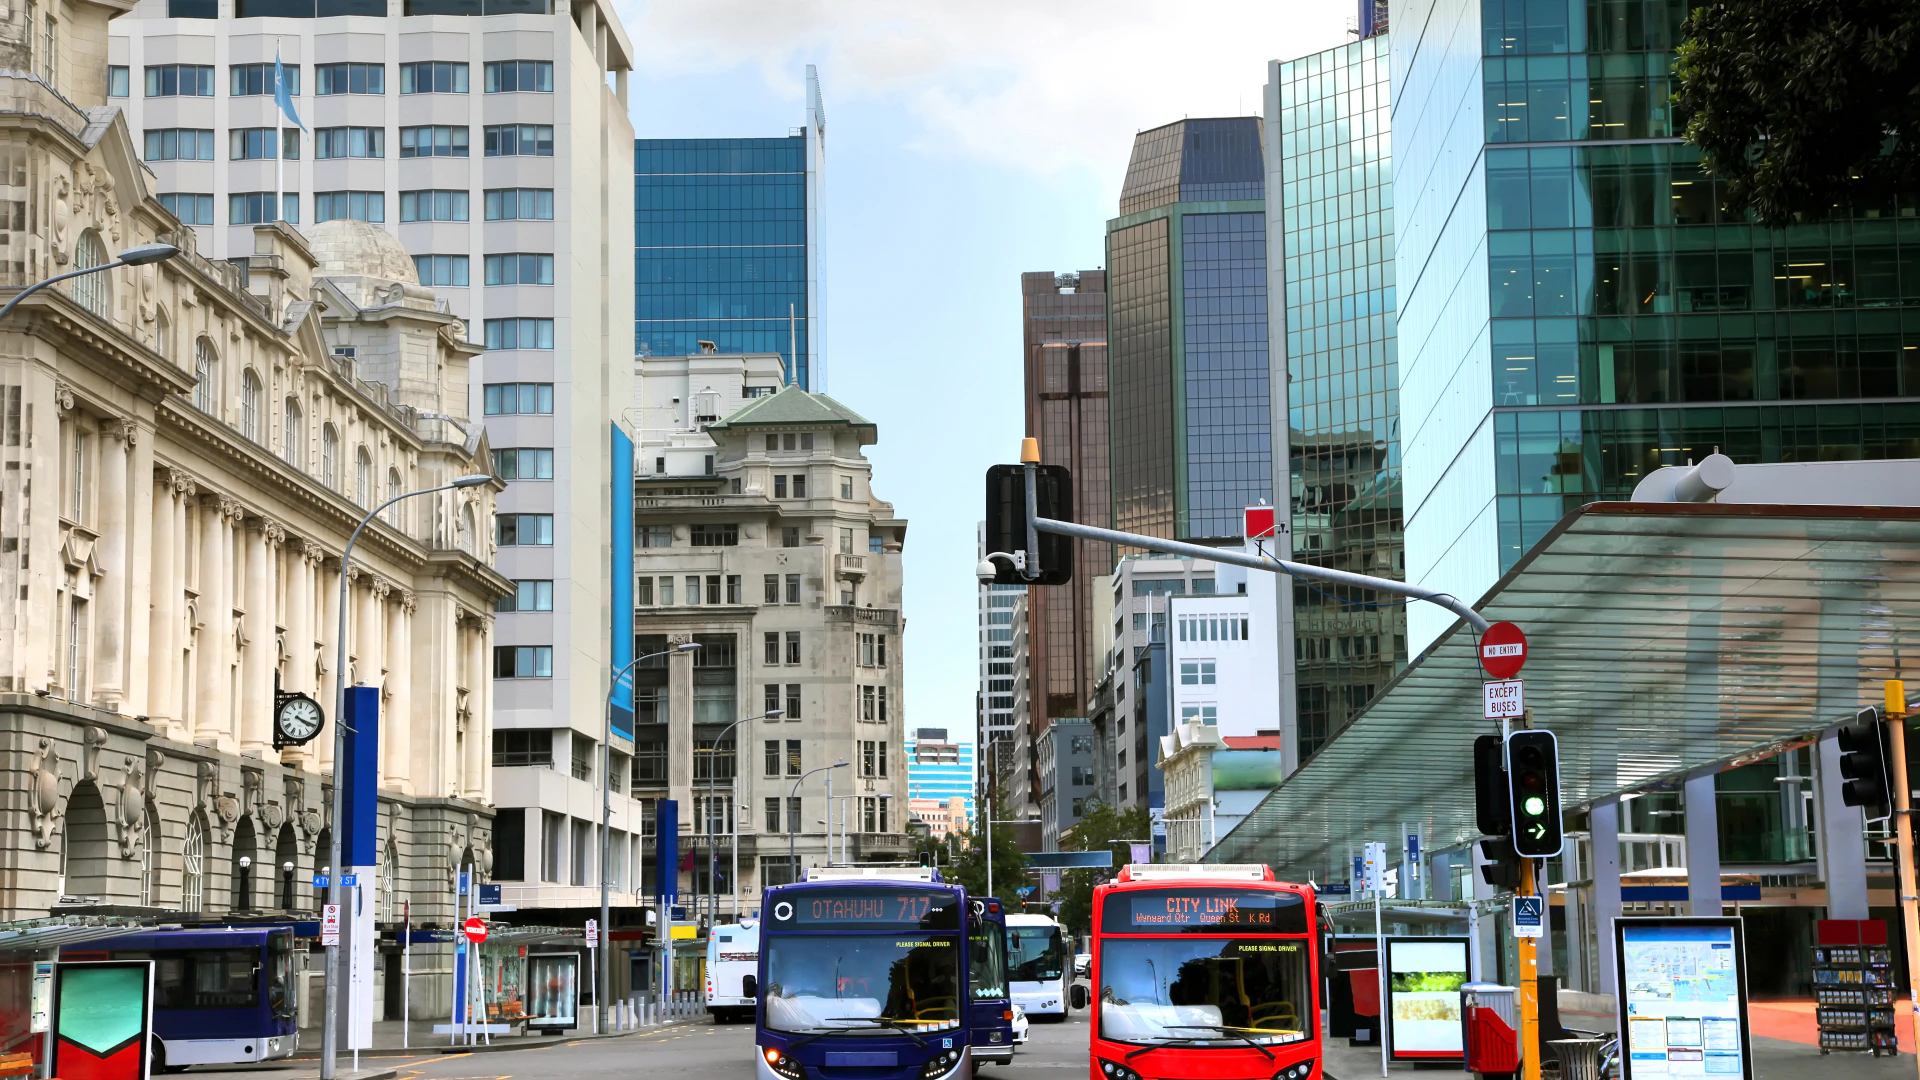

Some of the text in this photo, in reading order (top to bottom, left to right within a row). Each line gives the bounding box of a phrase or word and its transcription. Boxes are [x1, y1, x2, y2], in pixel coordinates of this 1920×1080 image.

[1488, 645, 1518, 655] NO ENTRY
[1489, 686, 1518, 698] EXCEPT
[1491, 700, 1517, 713] BUSES
[321, 876, 354, 885] TYR ST
[812, 896, 930, 920] OTAHUHU 717
[1166, 897, 1239, 913] CITY LINK
[1135, 912, 1271, 923] Wynyard Qtr Queen St K Rd
